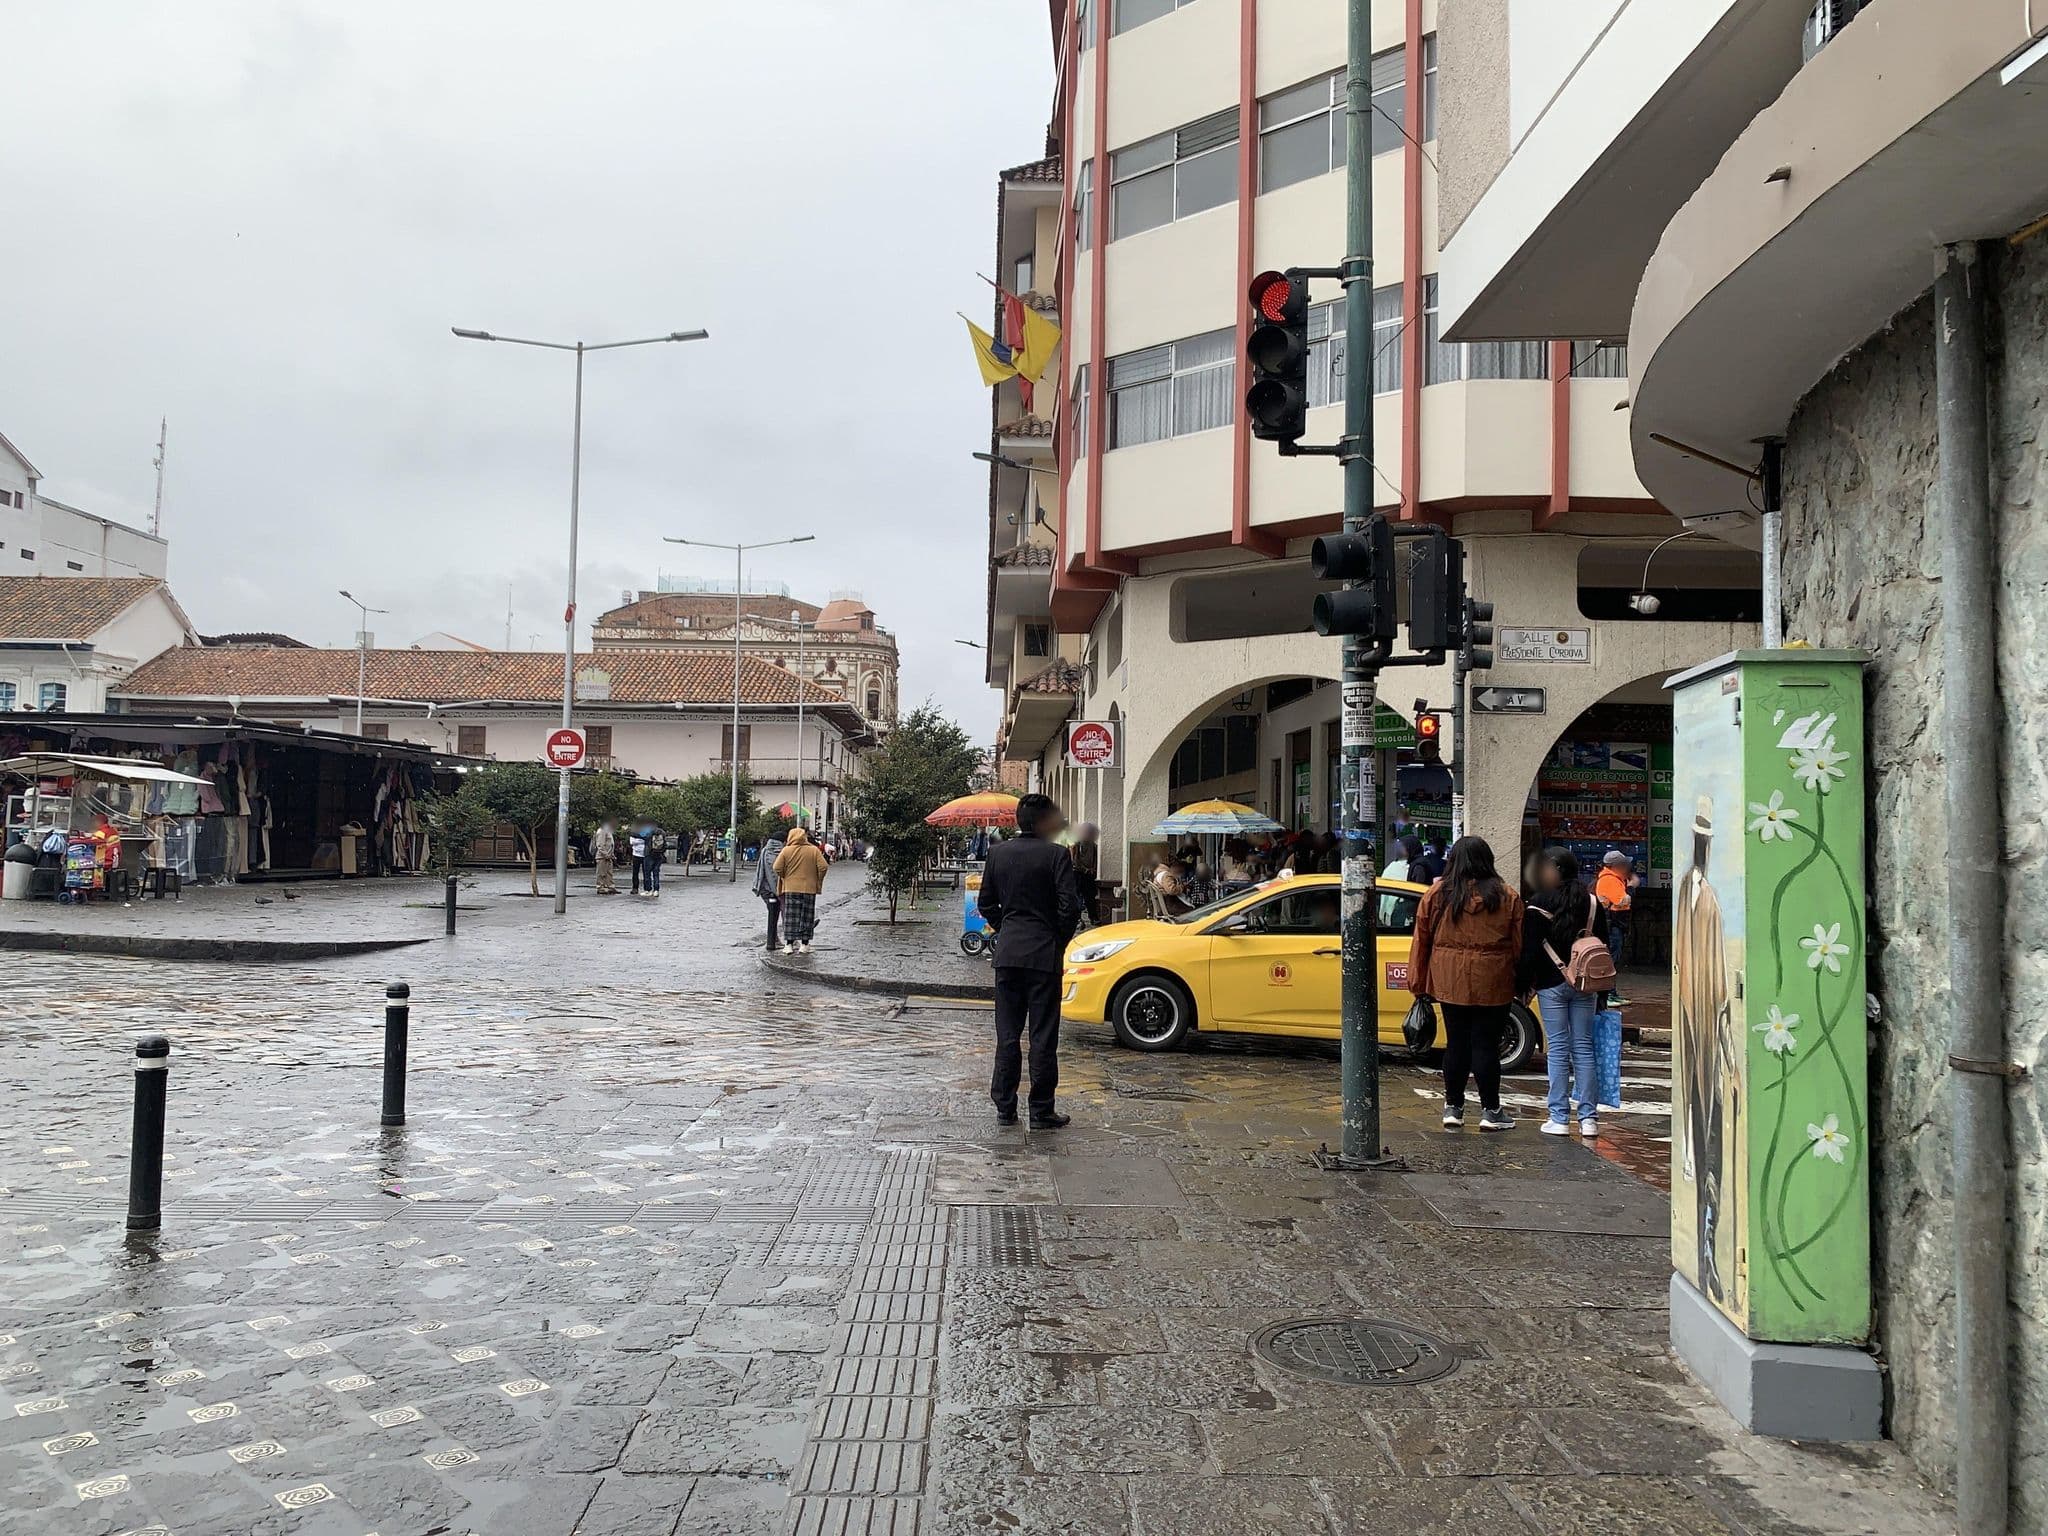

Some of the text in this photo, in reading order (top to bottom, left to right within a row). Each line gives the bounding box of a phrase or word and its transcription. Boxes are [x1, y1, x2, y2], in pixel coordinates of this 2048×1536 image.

[1086, 730, 1098, 739] NO
[560, 735, 572, 744] NO
[554, 752, 577, 760] ENTRE
[1079, 750, 1105, 758] ENTRE
